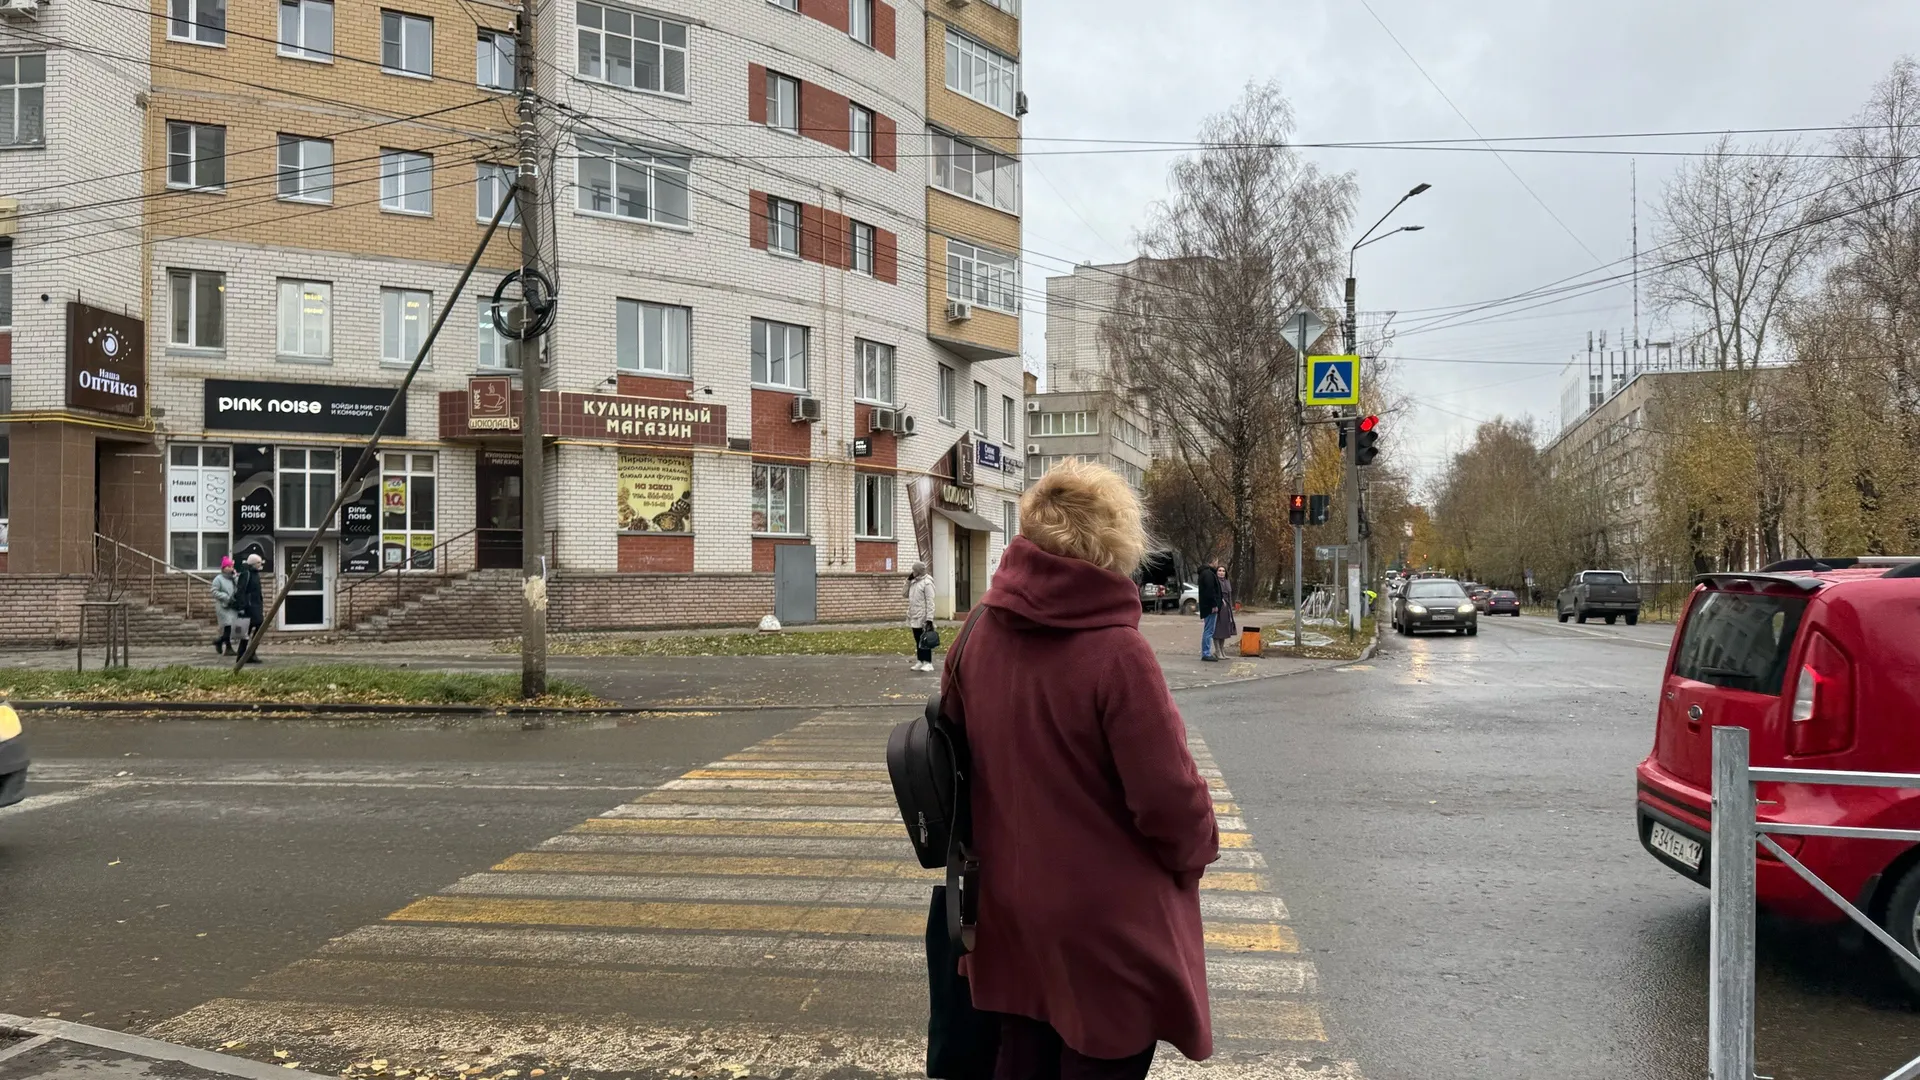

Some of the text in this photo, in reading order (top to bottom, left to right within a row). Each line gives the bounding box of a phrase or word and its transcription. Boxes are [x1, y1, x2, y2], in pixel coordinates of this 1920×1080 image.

[99, 368, 120, 380] Наша
[79, 370, 138, 398] Оптика
[218, 396, 322, 414] pink noise
[331, 402, 354, 410] ВОЙДИ
[337, 409, 373, 417] КОМФОРТА
[583, 400, 711, 424] КУЛИНАРНЫЙ
[606, 419, 692, 438] МАГАЗИН
[241, 505, 261, 513] pink
[348, 506, 367, 514] pink
